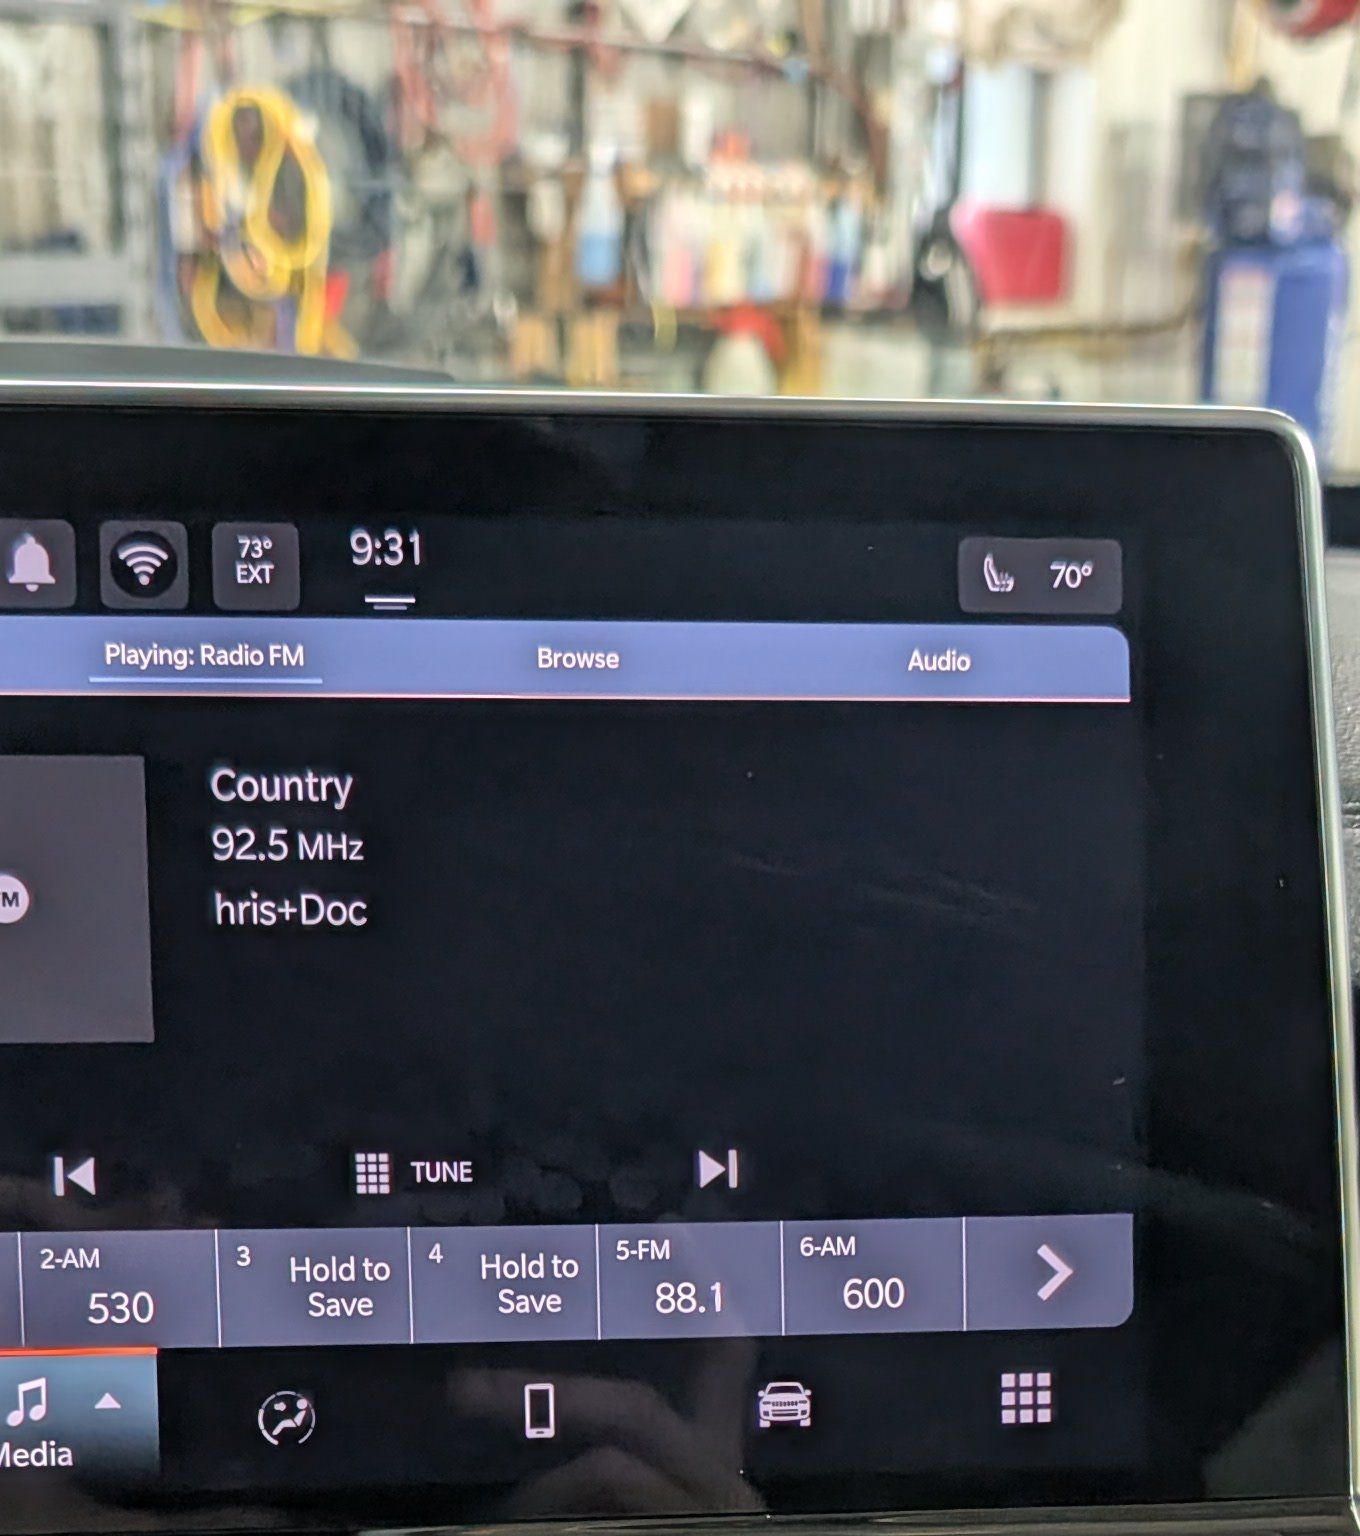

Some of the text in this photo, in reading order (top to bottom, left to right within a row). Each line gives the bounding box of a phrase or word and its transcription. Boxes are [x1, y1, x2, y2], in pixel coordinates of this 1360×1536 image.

[238, 536, 273, 561] 73°
[349, 528, 423, 568] 9:31
[236, 563, 275, 587] EXT
[1050, 561, 1093, 589] 70°
[104, 643, 305, 671] Playing: Radio FM
[537, 646, 620, 672] Browse
[907, 649, 972, 673] Audio
[210, 767, 354, 810] Country
[211, 830, 365, 863] 92.5 MHz
[214, 892, 368, 928] hris+Doc
[410, 1162, 473, 1184] TUNE
[40, 1248, 101, 1270] 2-AM
[236, 1246, 251, 1268] 3
[428, 1243, 444, 1264] 4
[615, 1239, 671, 1262] 5-FM
[799, 1235, 857, 1258] 6-AM
[288, 1256, 392, 1284] Hold to
[480, 1253, 580, 1282] Hold to
[307, 1291, 374, 1319] Save
[498, 1288, 563, 1315] Save
[653, 1281, 724, 1315] 88.1
[841, 1276, 906, 1311] 600
[87, 1291, 155, 1325] 530
